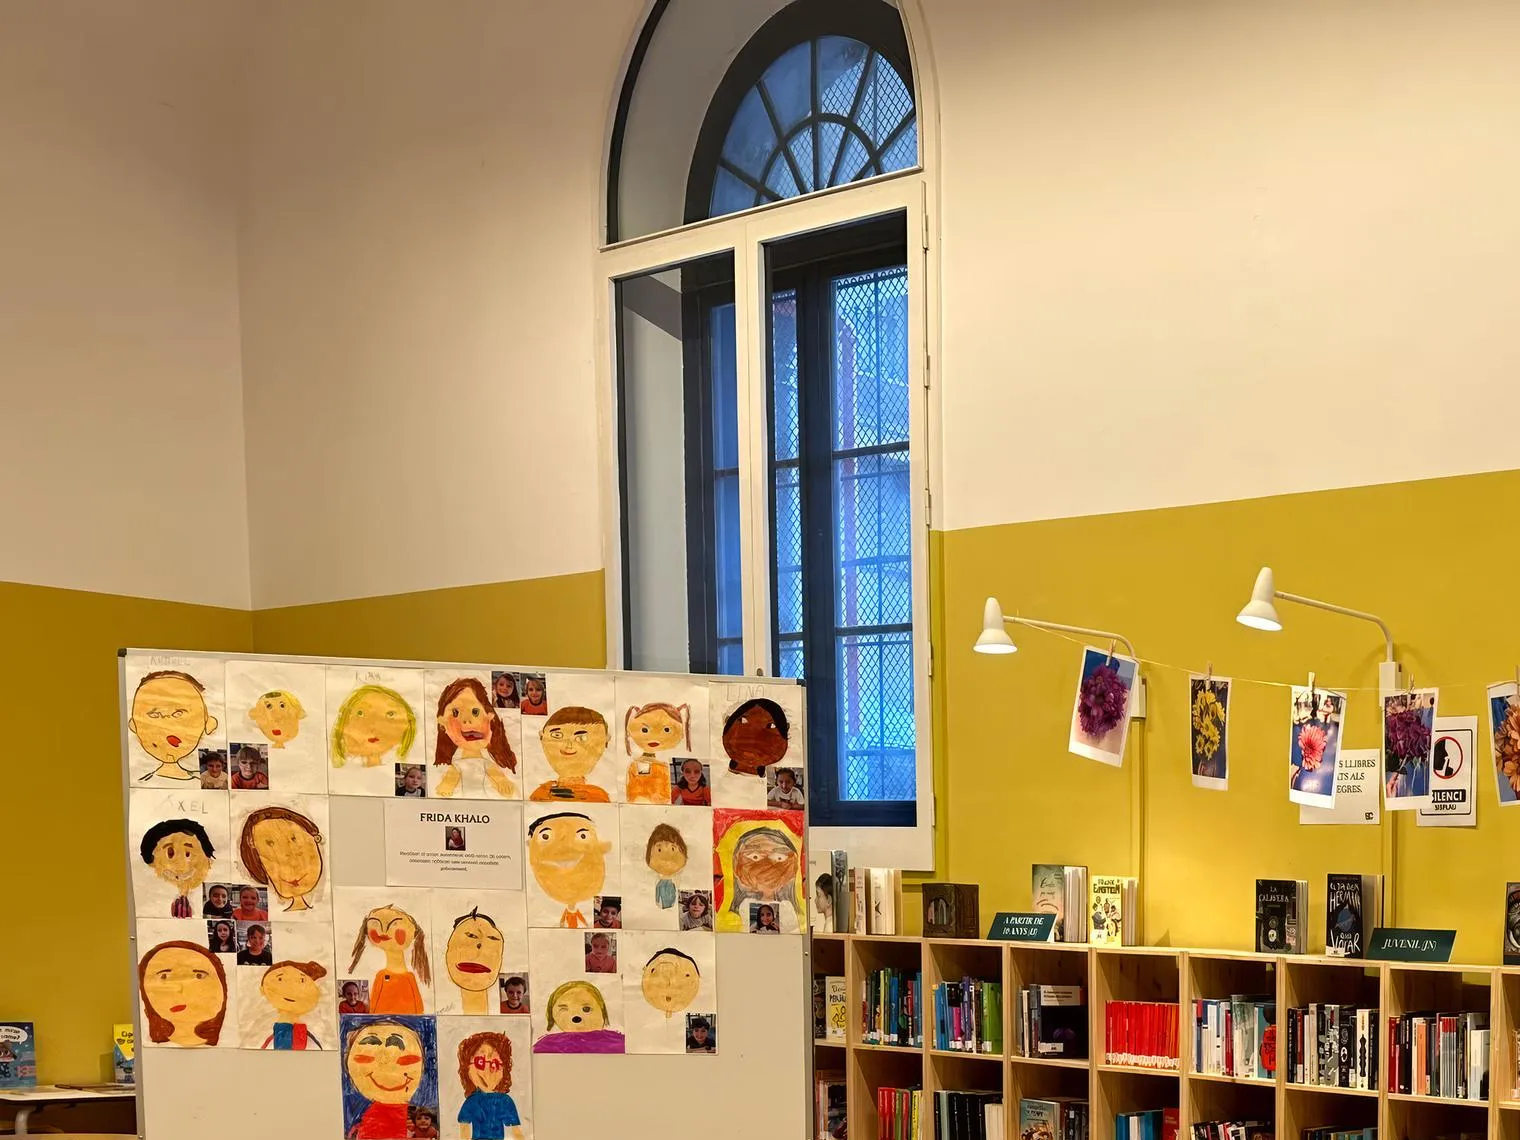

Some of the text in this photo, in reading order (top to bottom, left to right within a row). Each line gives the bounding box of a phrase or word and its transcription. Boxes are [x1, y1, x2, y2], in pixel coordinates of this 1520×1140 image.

[1345, 759, 1376, 769] LLIBRES
[1351, 772, 1365, 781] ALS
[420, 812, 490, 824] FRIDA KHALO
[1033, 917, 1045, 925] DE
[1381, 938, 1421, 950] JUVENIL
